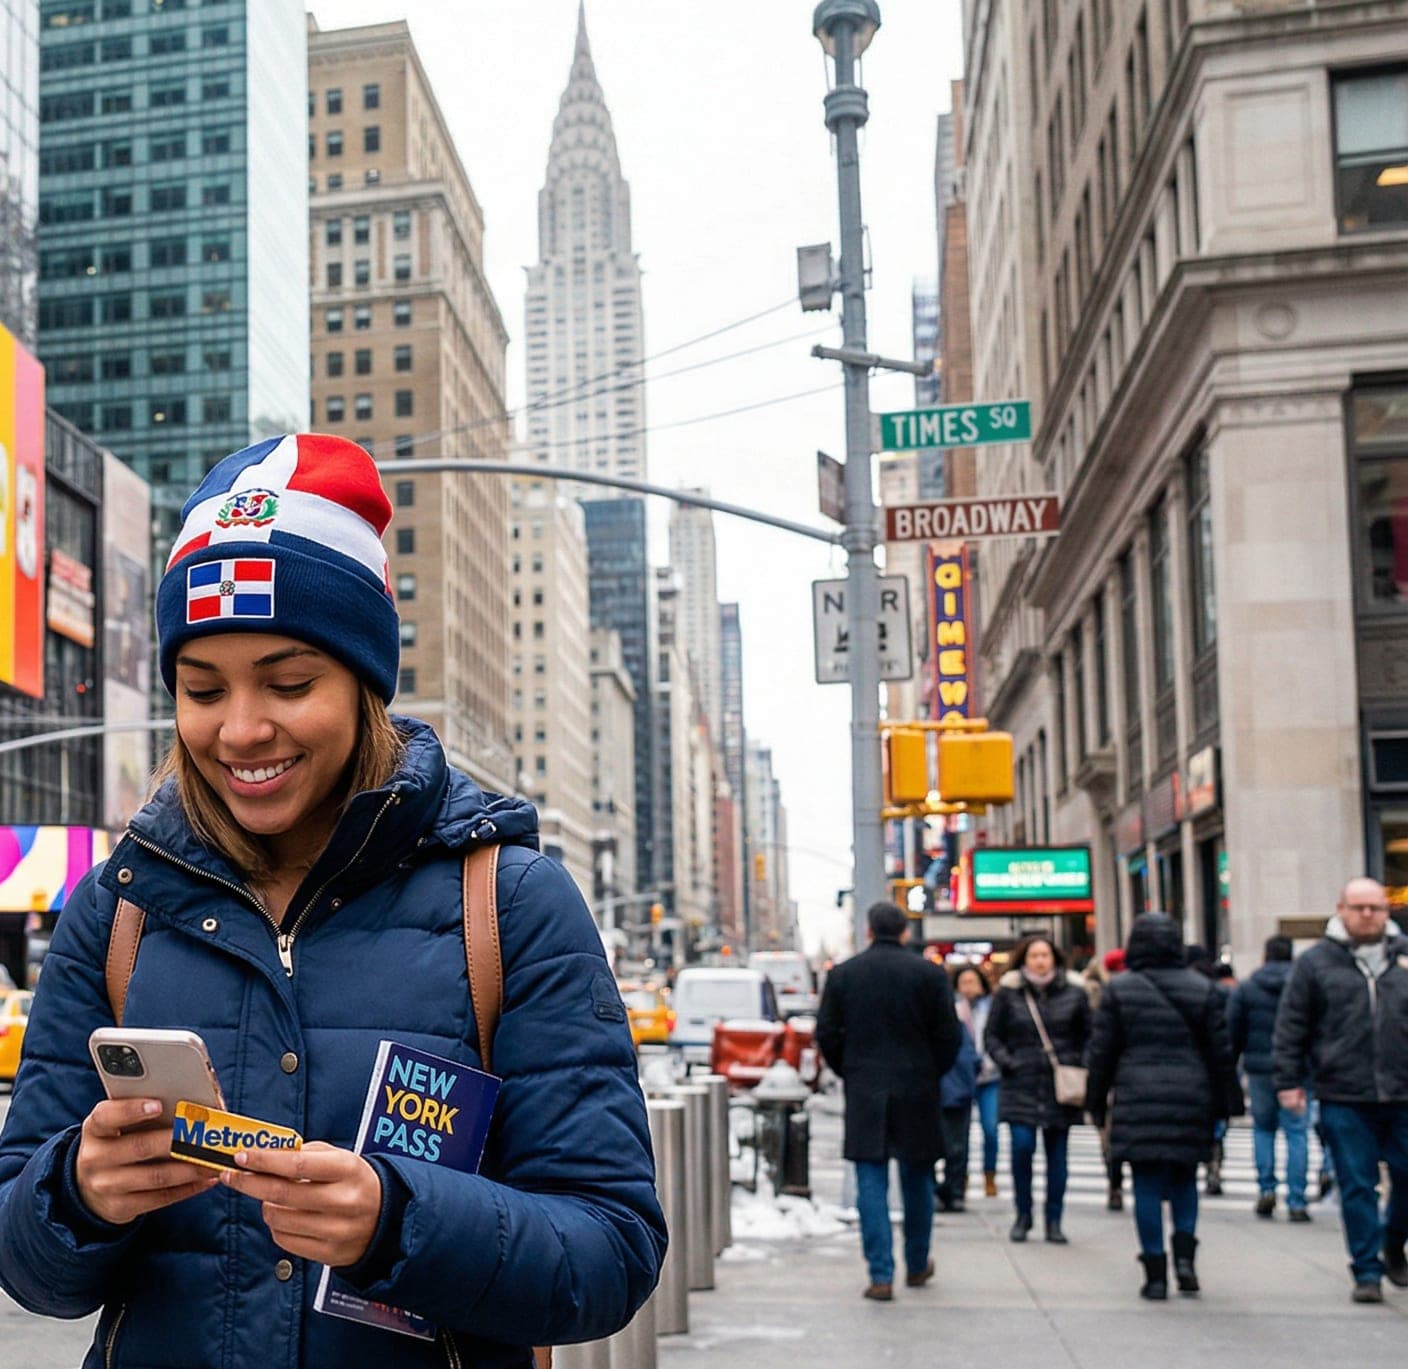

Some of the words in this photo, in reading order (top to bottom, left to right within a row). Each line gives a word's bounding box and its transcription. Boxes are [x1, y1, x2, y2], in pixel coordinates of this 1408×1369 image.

[891, 409, 980, 448] TIMES
[989, 405, 1017, 429] SQ
[895, 499, 1049, 538] BROADWAY
[388, 1055, 457, 1100] NEW
[385, 1085, 460, 1135] YORK
[171, 1116, 297, 1149] MetroCard
[374, 1116, 442, 1162] PASS
